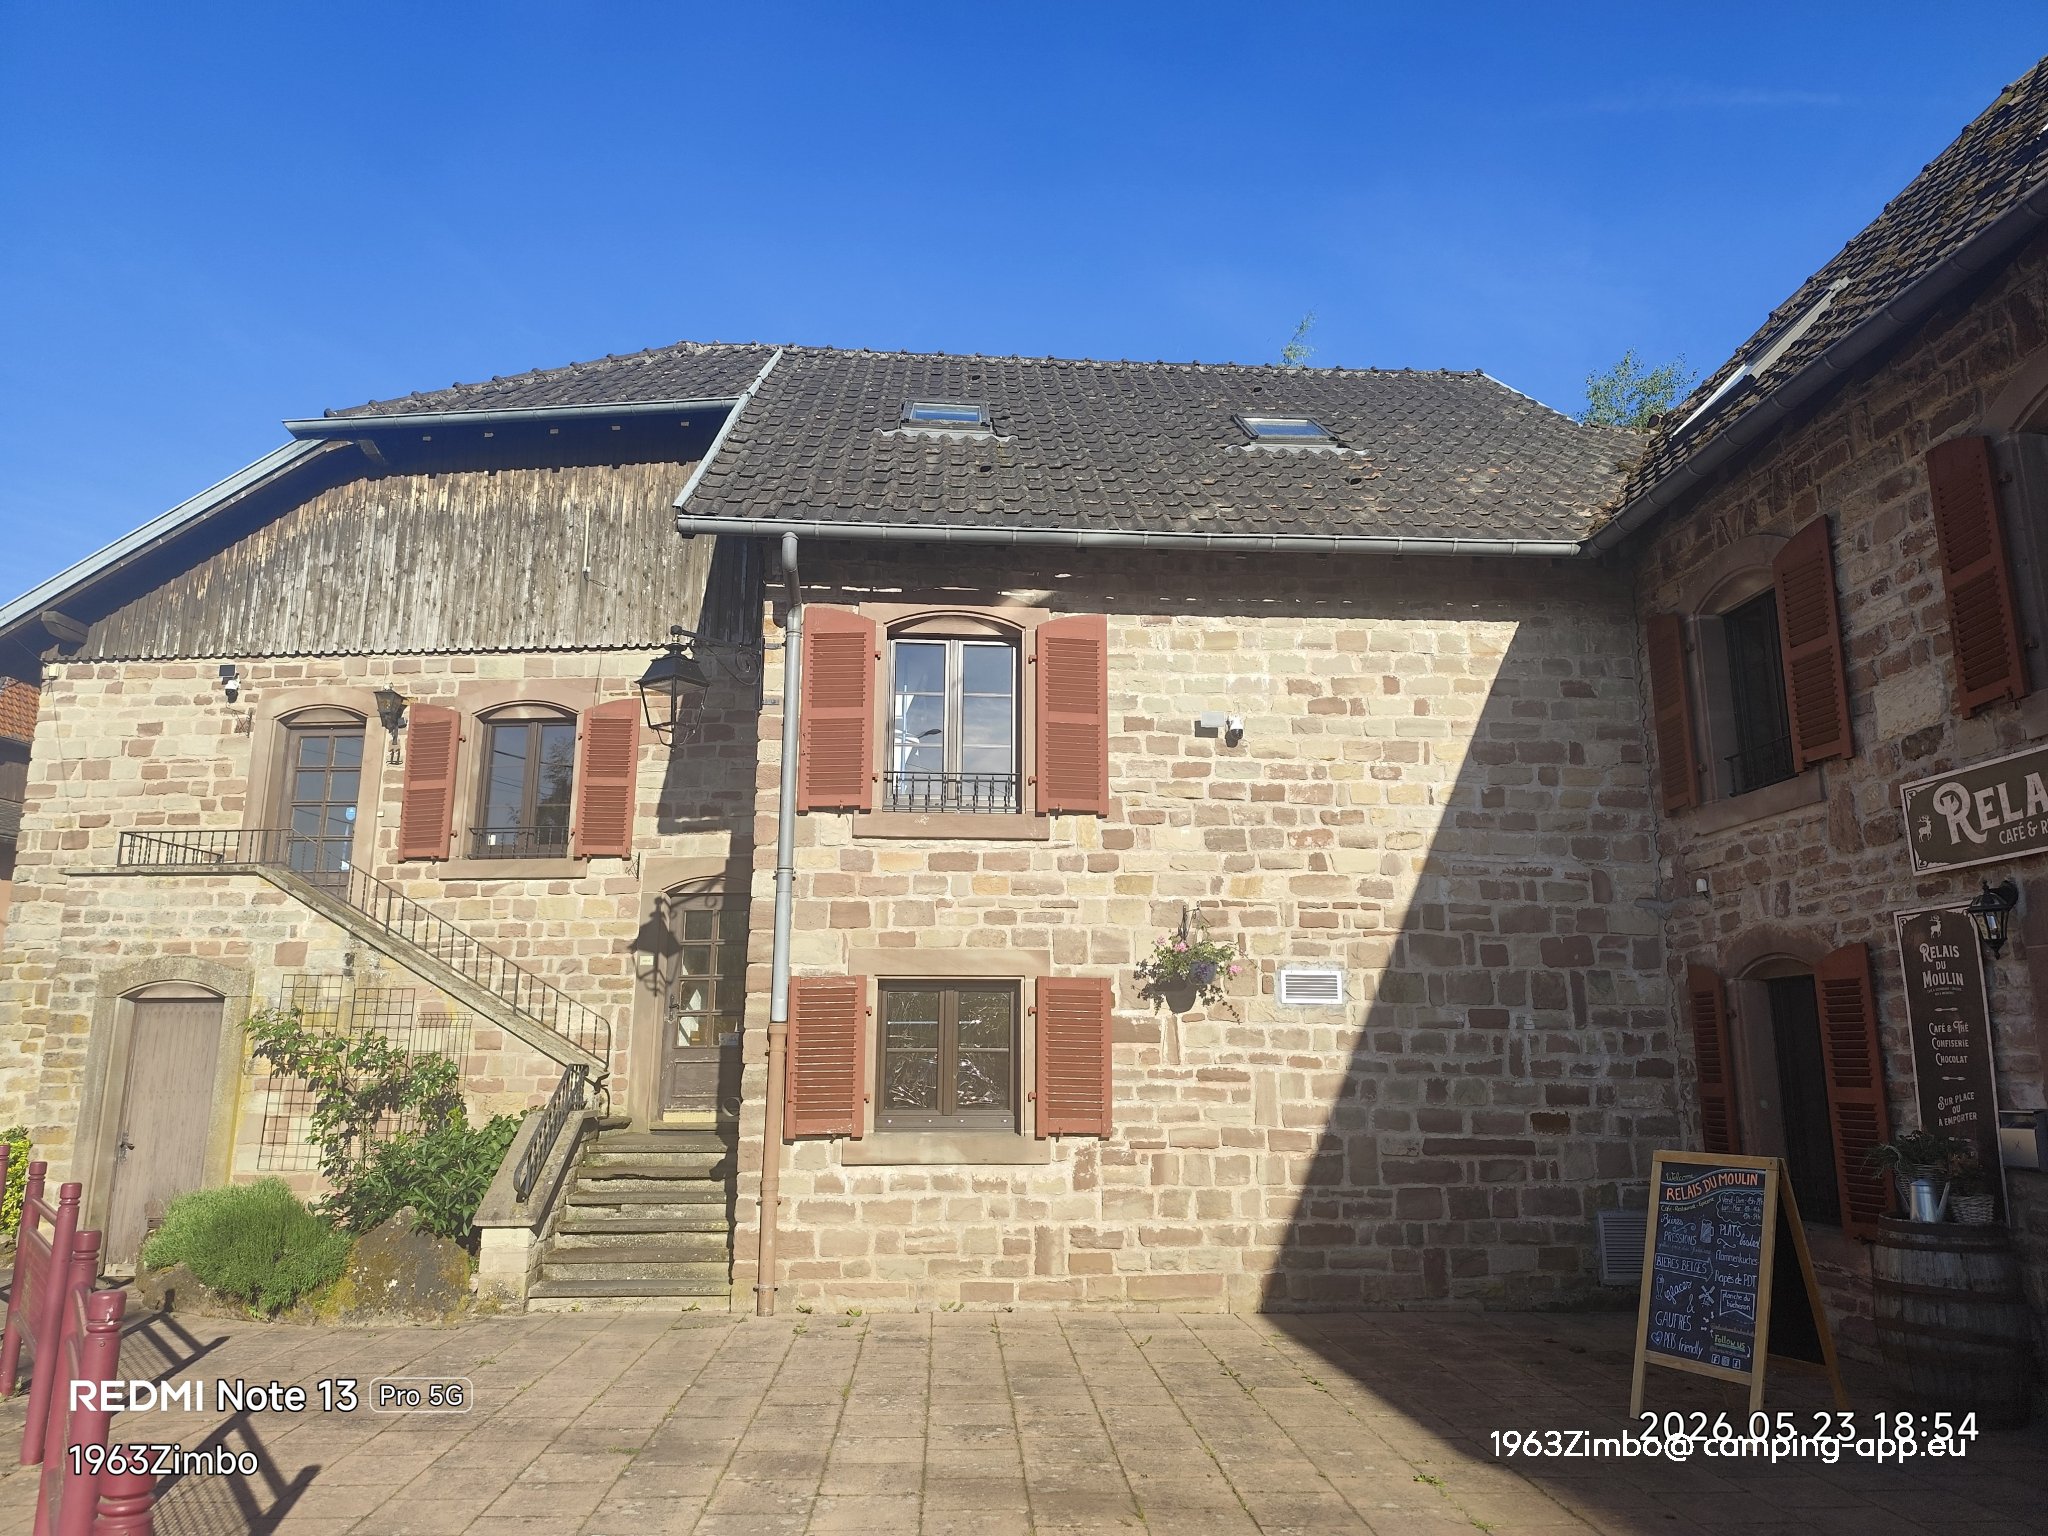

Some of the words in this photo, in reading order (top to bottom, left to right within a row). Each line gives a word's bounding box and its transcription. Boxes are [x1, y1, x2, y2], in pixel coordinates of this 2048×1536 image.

[1933, 772, 2048, 845] RELA
[1999, 822, 2026, 845] CAFÉ
[2027, 821, 2038, 837] &
[1919, 943, 1960, 962] RELAIS
[1935, 960, 1947, 970] DU
[1922, 970, 1964, 989] MOULIN
[1929, 1022, 1946, 1036] CAFÉ
[1946, 1024, 1952, 1033] &
[1952, 1020, 1969, 1034] THÉ
[1931, 1037, 1970, 1050] CONFISERIE
[1935, 1052, 1968, 1066] CHOCOLAT
[1937, 1095, 1954, 1111] SUR
[1954, 1091, 1975, 1104] PLACE
[1951, 1104, 1961, 1114] OU
[1944, 1111, 1978, 1126] EMPORTER
[1666, 1182, 1702, 1200] RELAIS
[1702, 1176, 1717, 1192] DU
[1718, 1173, 1758, 1186] MOULIN
[1663, 1230, 1697, 1246] PRESSIONS
[1719, 1223, 1742, 1238] PLATS
[1655, 1310, 1692, 1332] GAUFRES
[1714, 1334, 1736, 1347] Follow
